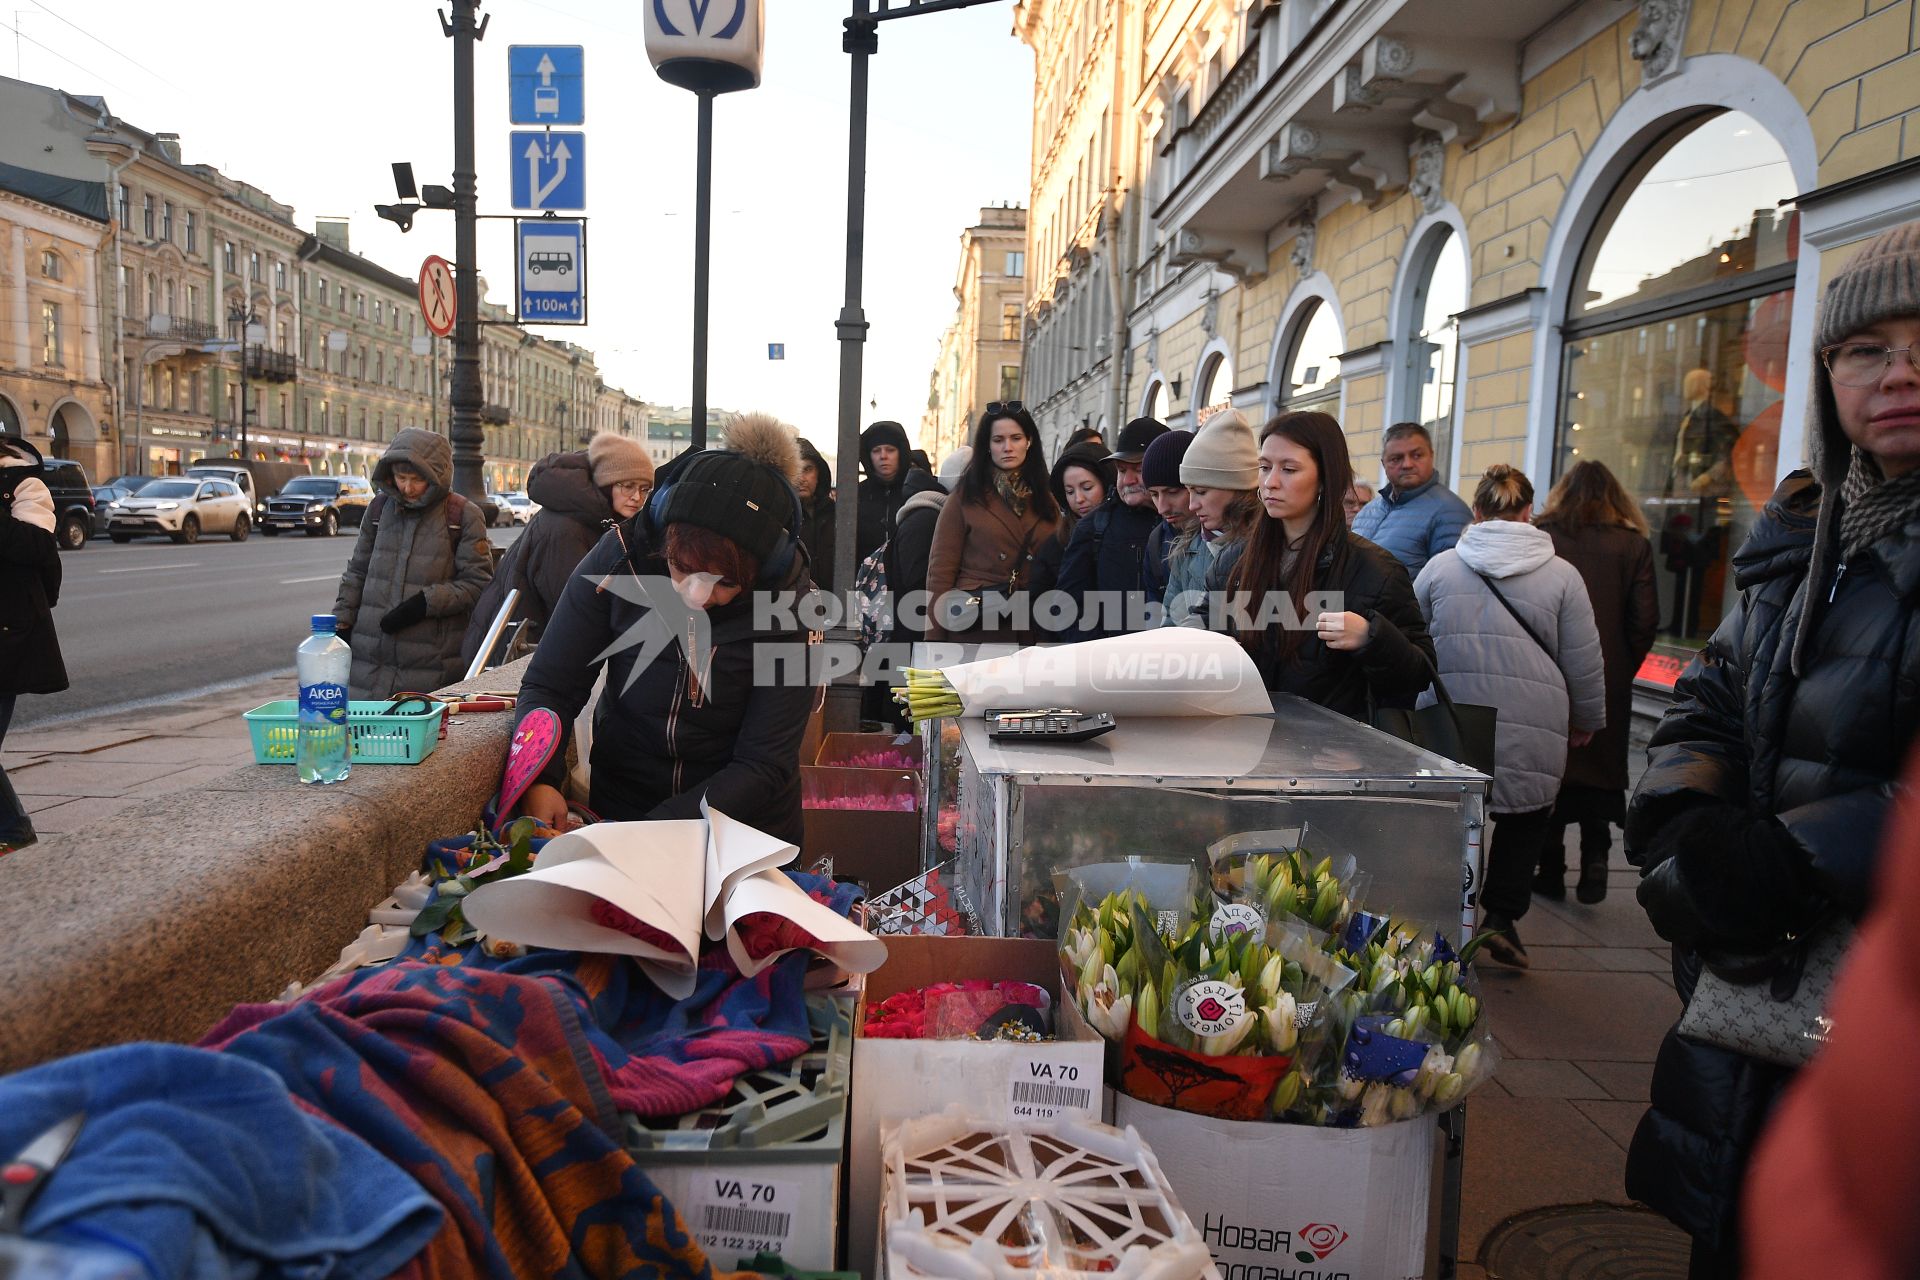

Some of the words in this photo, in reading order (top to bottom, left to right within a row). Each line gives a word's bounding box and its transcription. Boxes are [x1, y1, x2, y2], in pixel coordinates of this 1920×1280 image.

[535, 298, 568, 312] 100м
[309, 687, 343, 701] АКВА
[1185, 985, 1228, 1005] sian
[1183, 1003, 1243, 1034] flowers
[1030, 1062, 1053, 1078] VA
[1059, 1065, 1079, 1081] 70
[1014, 1106, 1032, 1117] 644
[1036, 1108, 1053, 1118] 119
[715, 1179, 744, 1199] VA
[751, 1183, 776, 1203] 70
[722, 1235, 745, 1250] 122
[1203, 1212, 1291, 1254] Новая
